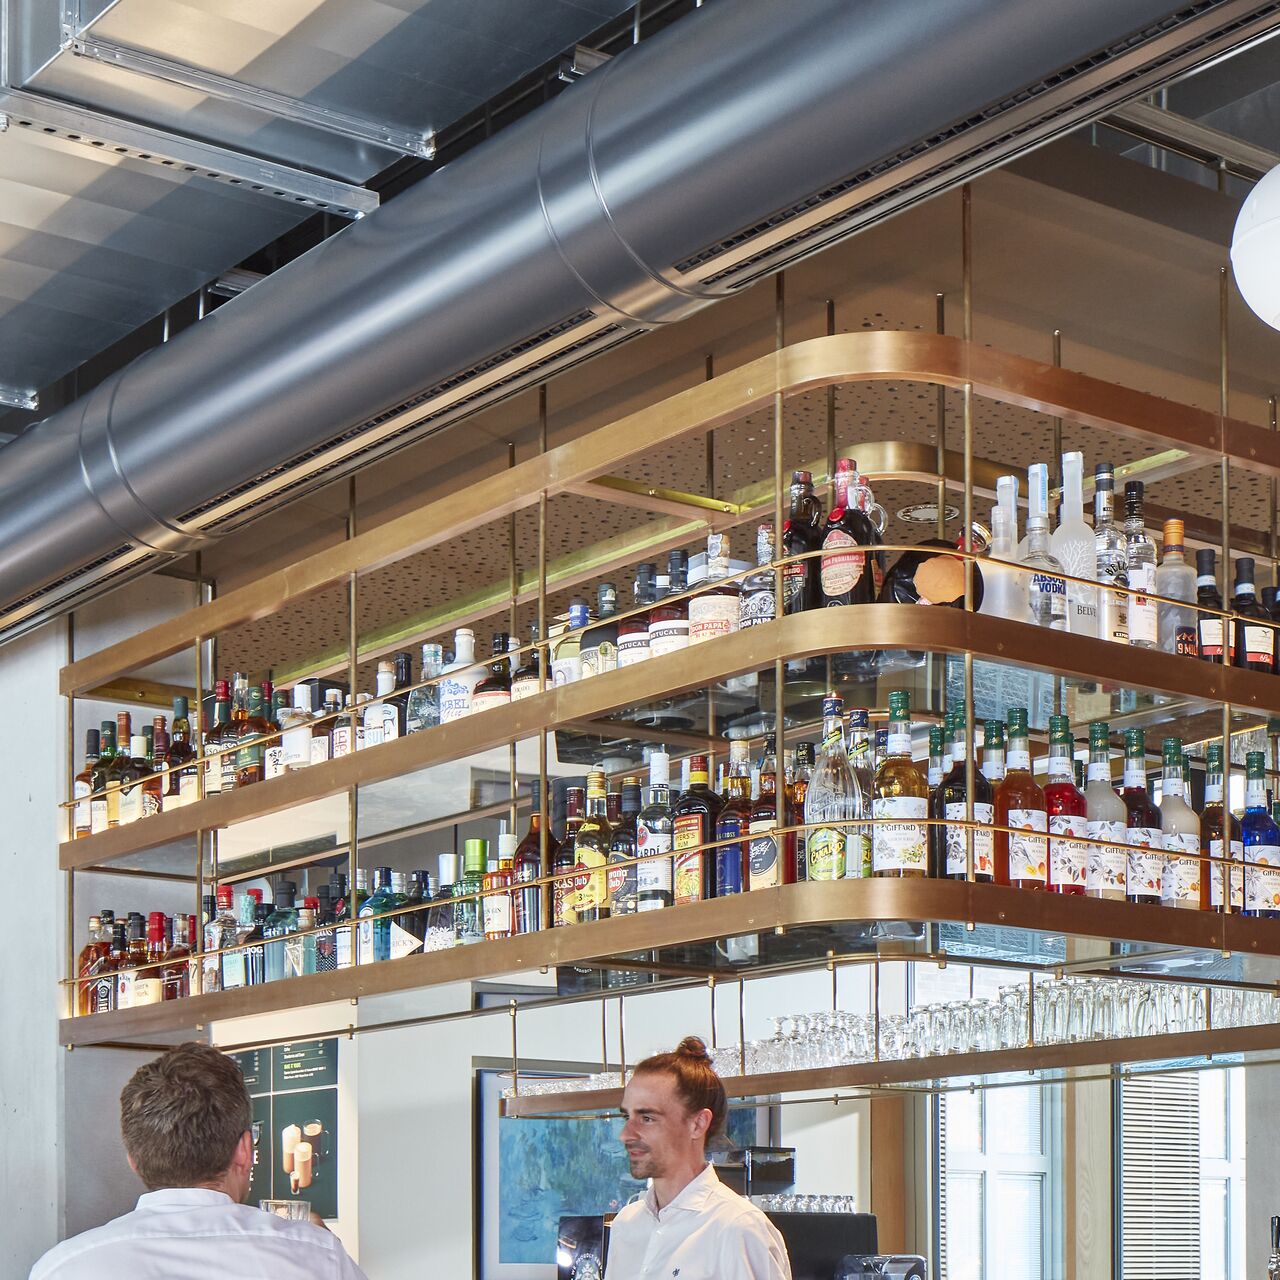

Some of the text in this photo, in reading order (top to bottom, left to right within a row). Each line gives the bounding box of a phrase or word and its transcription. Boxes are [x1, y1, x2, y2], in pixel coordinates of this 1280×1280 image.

[1077, 604, 1097, 617] BELVE
[704, 622, 723, 630] PAPA
[1177, 643, 1184, 654] 9
[886, 824, 916, 832] GIFFARD
